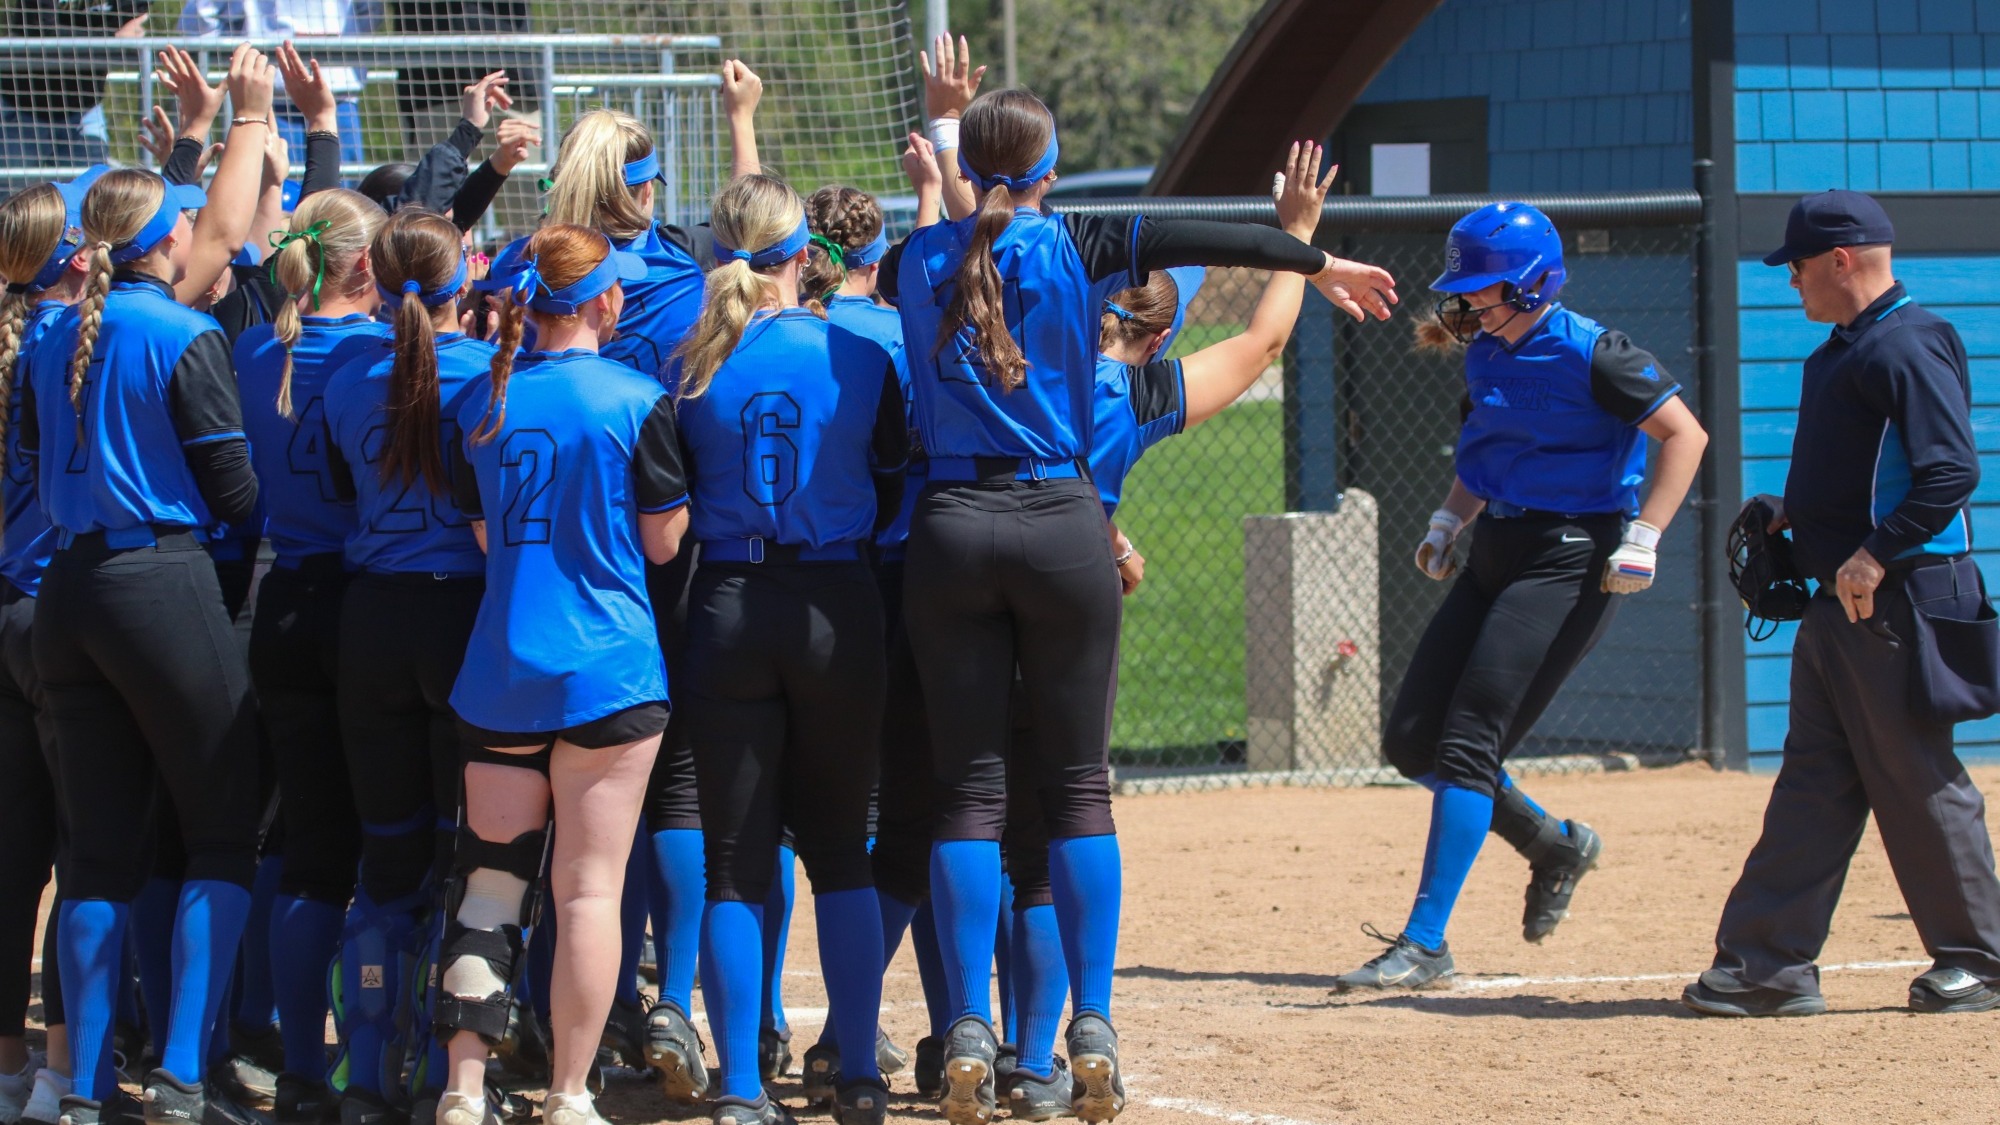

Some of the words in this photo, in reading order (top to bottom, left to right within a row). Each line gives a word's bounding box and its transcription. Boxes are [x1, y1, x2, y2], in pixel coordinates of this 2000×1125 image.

[65, 358, 105, 473] 7
[740, 391, 801, 507] 6
[500, 428, 557, 547] 2
